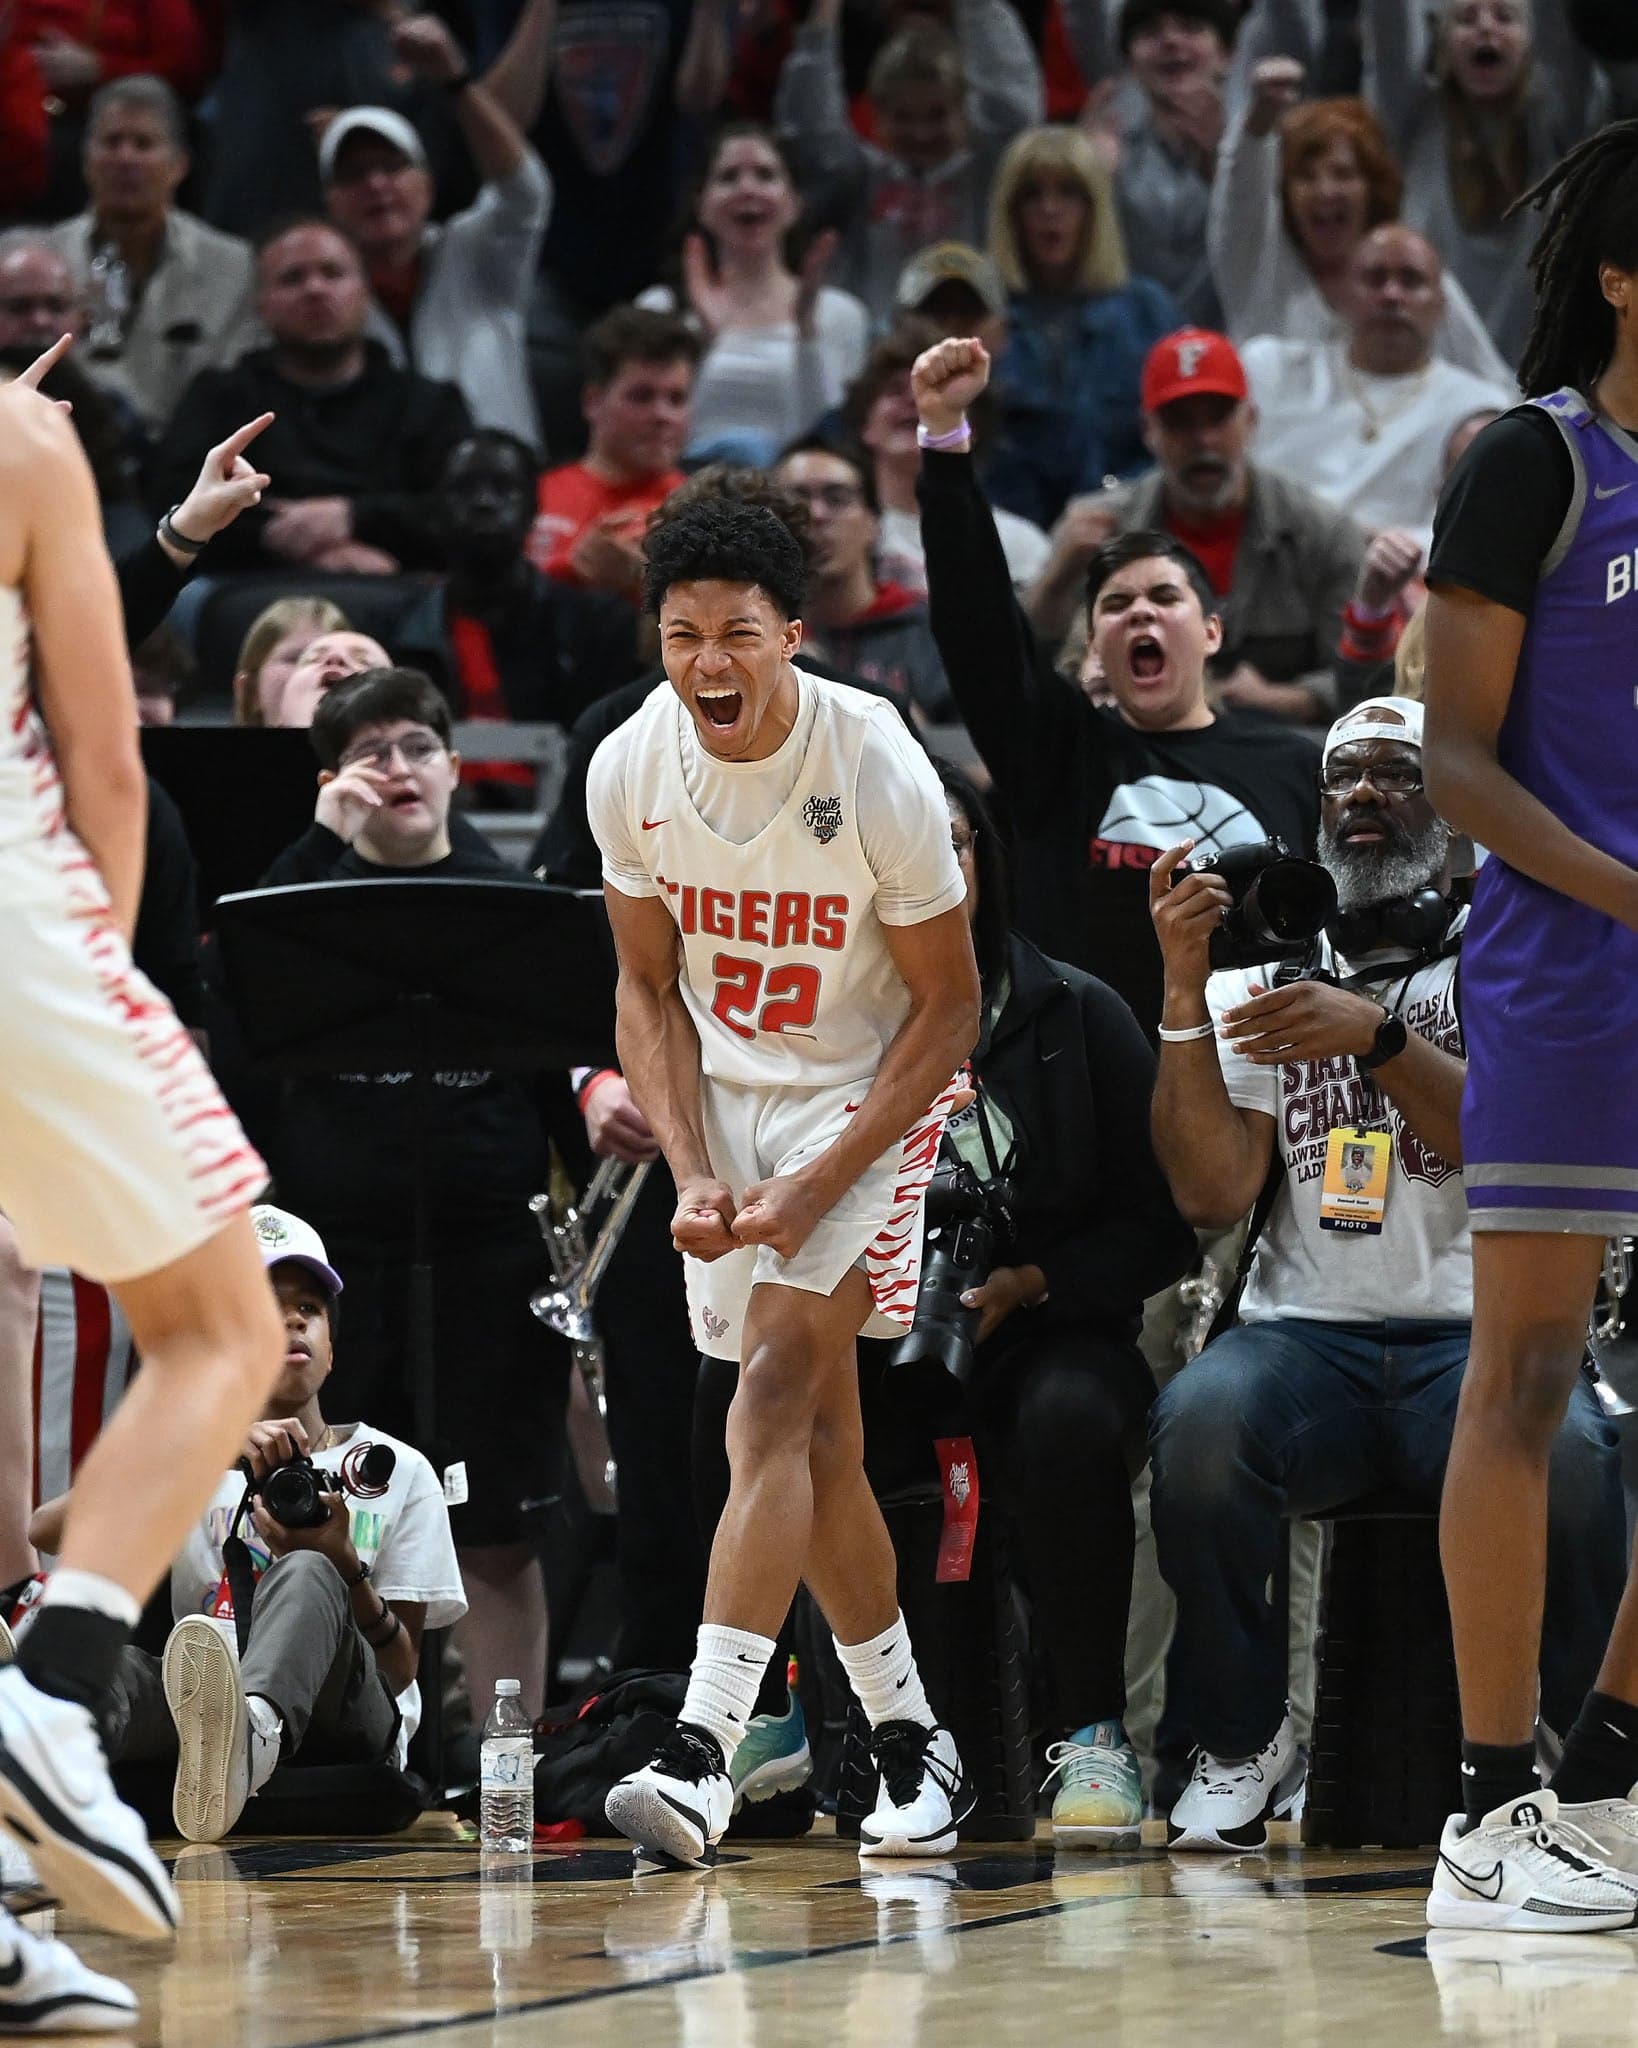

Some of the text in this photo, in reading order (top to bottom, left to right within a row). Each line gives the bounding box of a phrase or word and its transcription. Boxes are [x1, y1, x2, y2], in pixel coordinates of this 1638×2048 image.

[1174, 340, 1208, 377] F
[1606, 549, 1638, 605] B
[803, 795, 841, 812] State
[803, 810, 843, 828] Finals
[711, 952, 822, 1041] 22
[1406, 990, 1443, 1026] CLAS
[1283, 1054, 1359, 1098] STAT
[1284, 1077, 1391, 1148] CHAM
[1286, 1140, 1329, 1170] LAWRE
[1334, 1220, 1368, 1230] PHOTO
